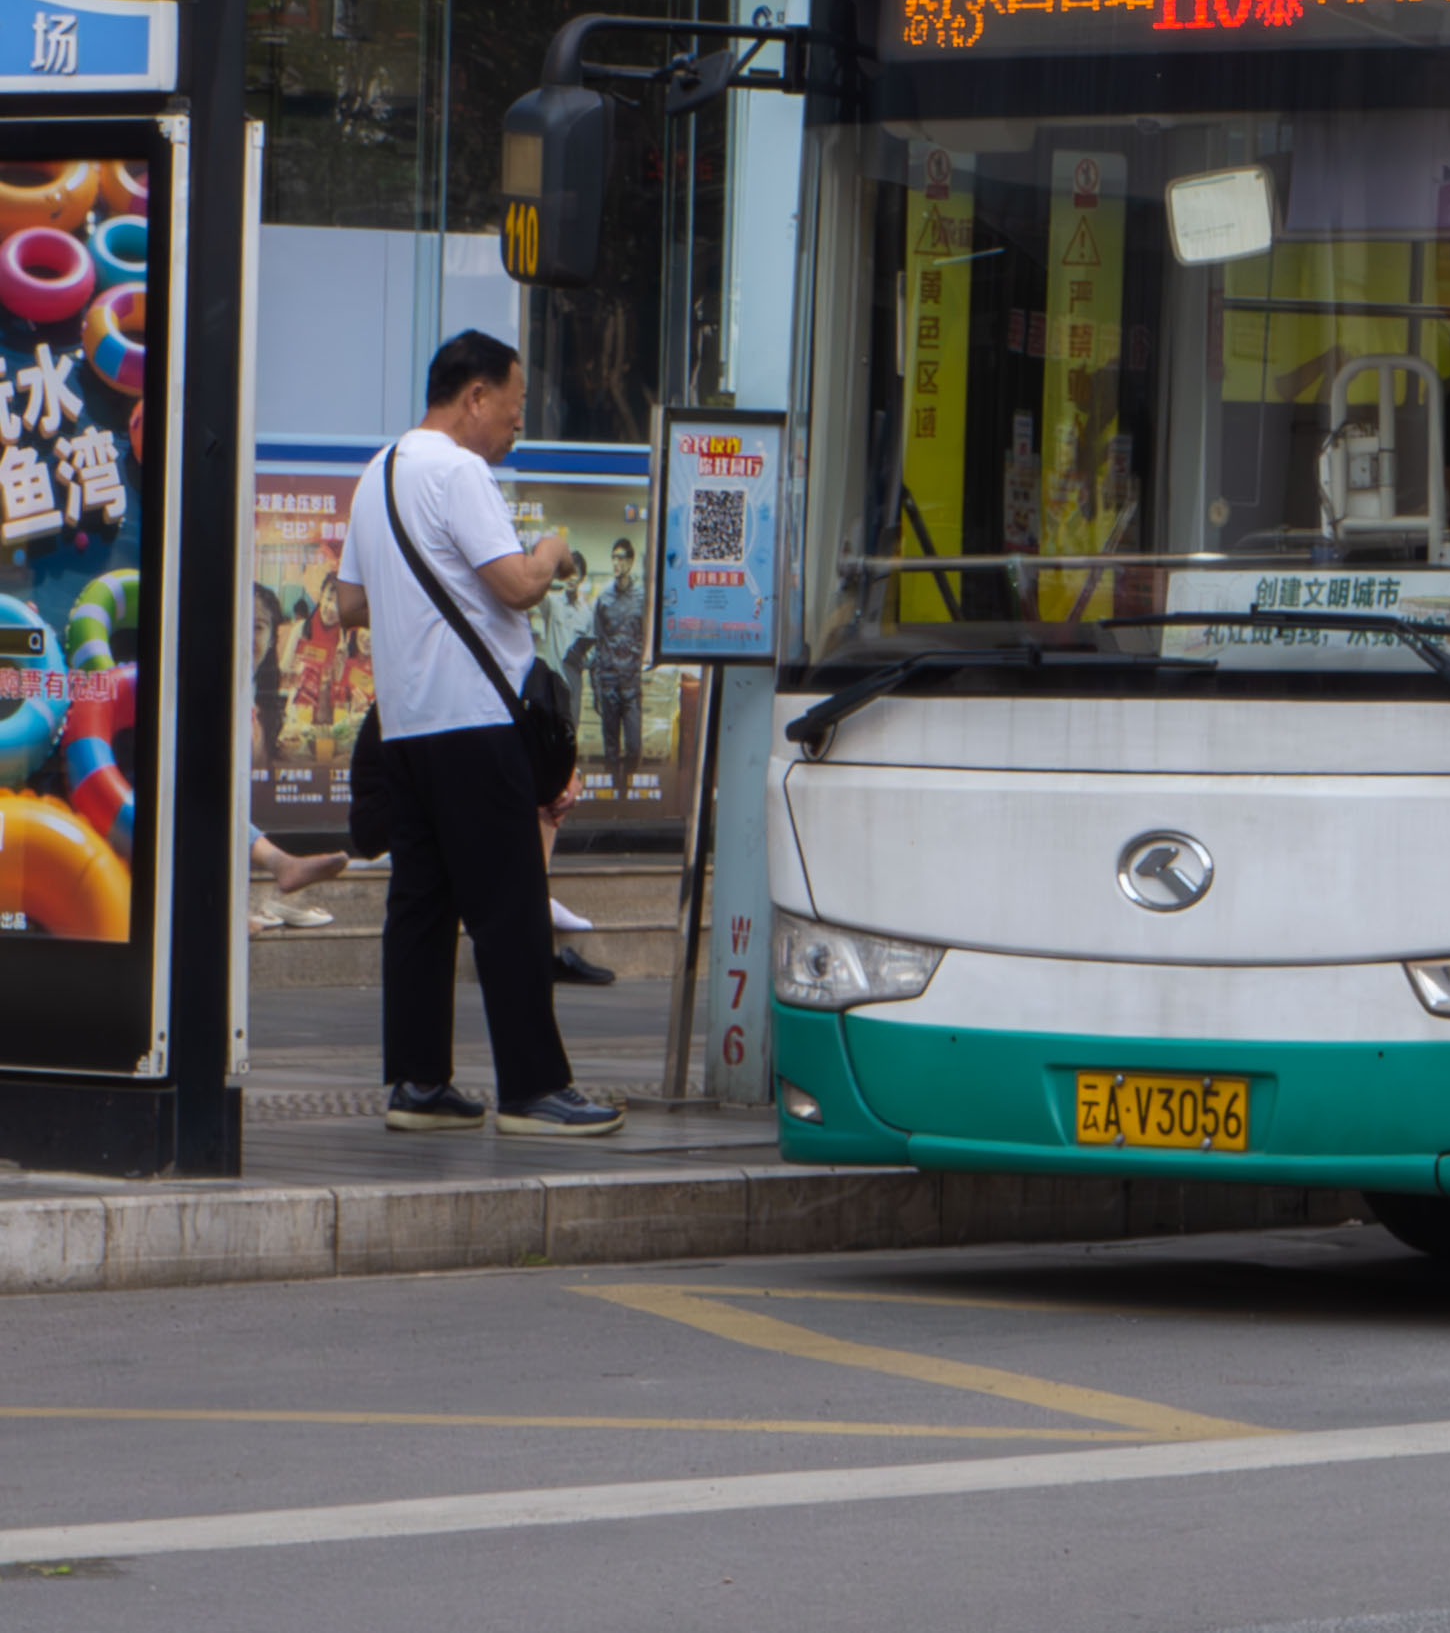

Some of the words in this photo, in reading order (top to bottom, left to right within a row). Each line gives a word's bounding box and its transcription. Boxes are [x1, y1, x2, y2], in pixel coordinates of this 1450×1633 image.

[504, 200, 539, 277] 110
[1256, 576, 1402, 609] 创建文明城市
